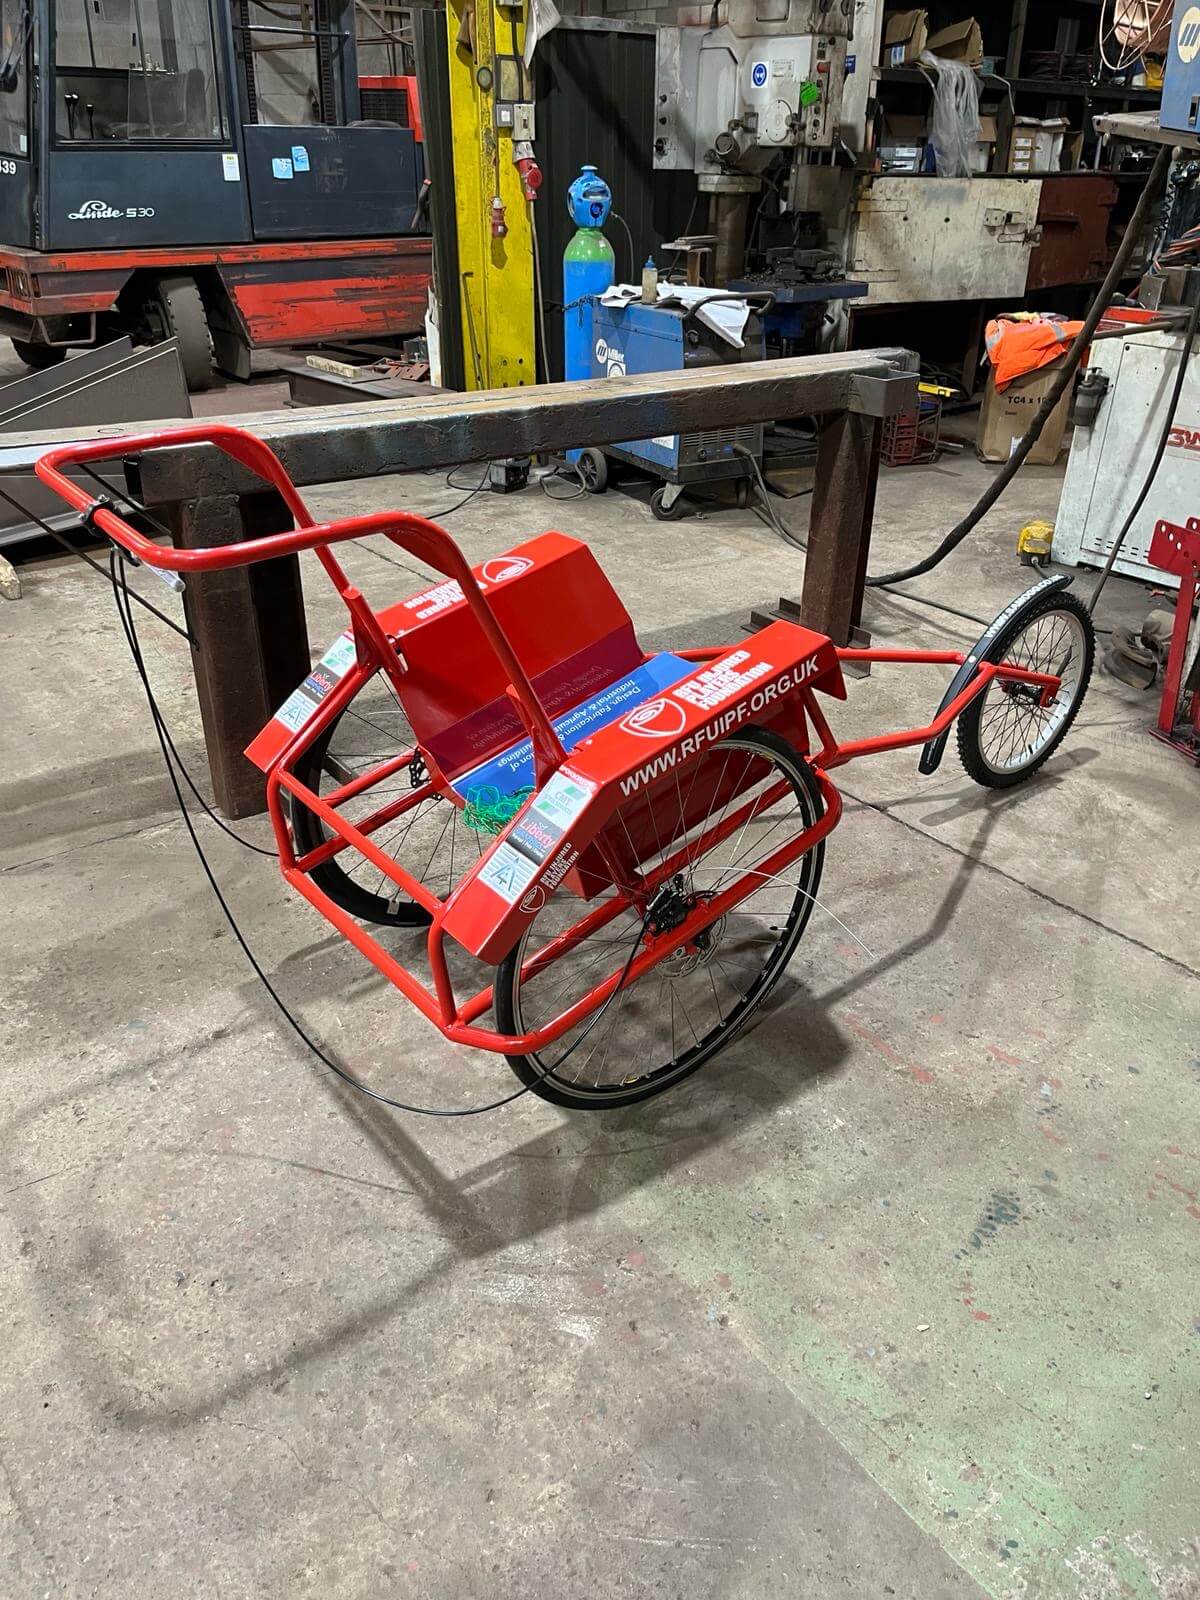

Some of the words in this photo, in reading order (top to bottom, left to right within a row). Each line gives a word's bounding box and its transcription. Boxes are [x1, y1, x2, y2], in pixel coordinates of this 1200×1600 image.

[68, 200, 124, 220] Linde
[1008, 396, 1026, 404] TC4
[672, 680, 704, 698] RFU
[696, 650, 751, 684] INJURED
[686, 669, 740, 704] PLAYERS
[695, 662, 774, 711] FOUNDATION
[596, 679, 636, 706] Industrial
[564, 704, 612, 736] Fabrication
[619, 655, 819, 797] WWW.RFUIPF.ORG.UK
[498, 741, 533, 767] uildings
[510, 762, 521, 772] of
[519, 817, 556, 849] Liberty
[548, 850, 580, 890] FOUNDATION
[549, 842, 572, 869] INJURED
[544, 858, 567, 887] PLAYERS
